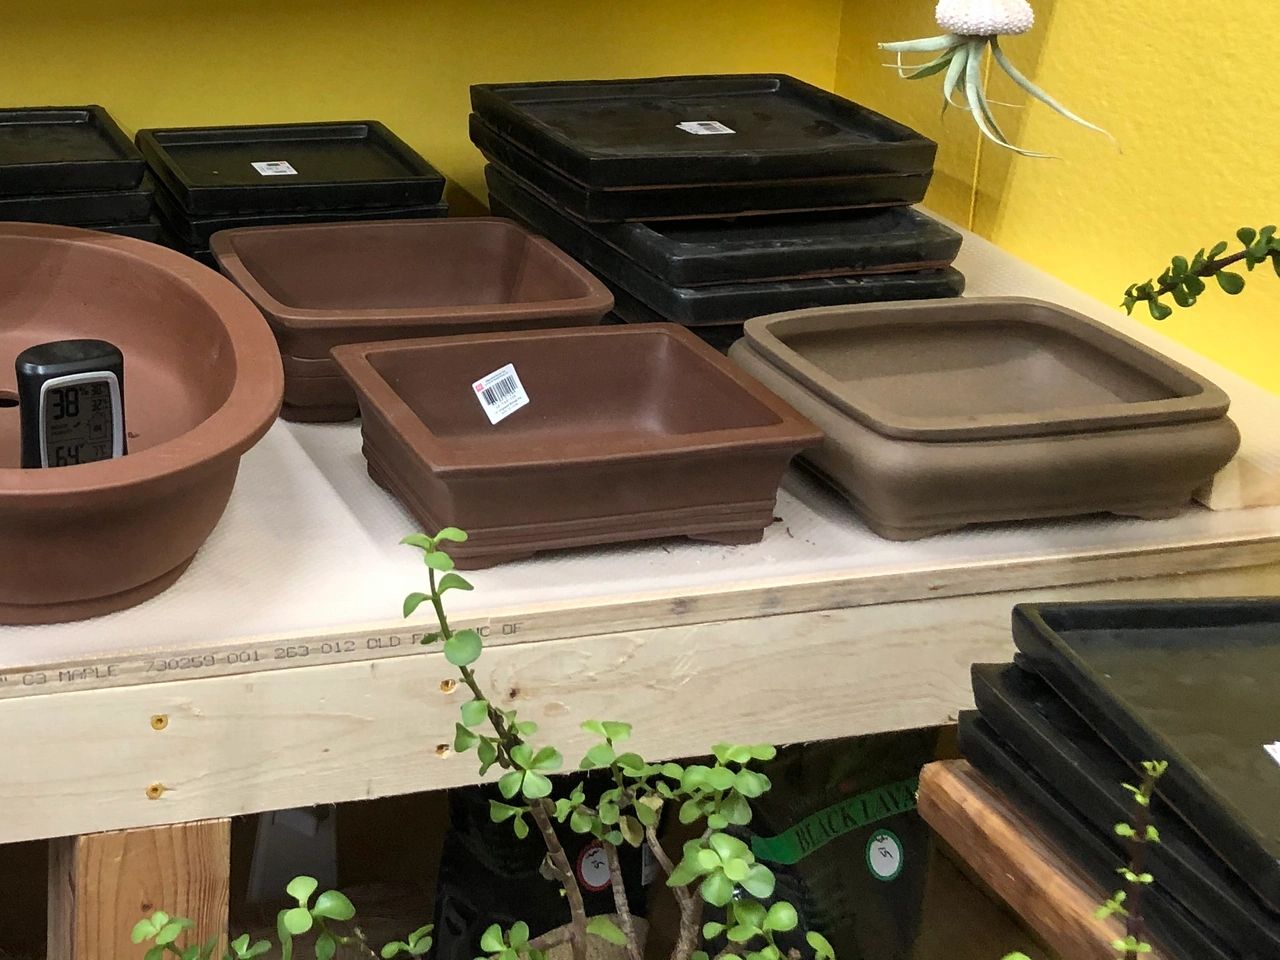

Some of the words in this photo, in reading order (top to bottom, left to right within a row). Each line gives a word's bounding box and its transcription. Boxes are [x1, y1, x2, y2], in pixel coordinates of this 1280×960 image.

[53, 387, 80, 421] 38
[59, 664, 120, 682] MAPLE
[274, 641, 356, 660] 263-012
[366, 635, 401, 650] OLD
[795, 806, 858, 852] BLACK
